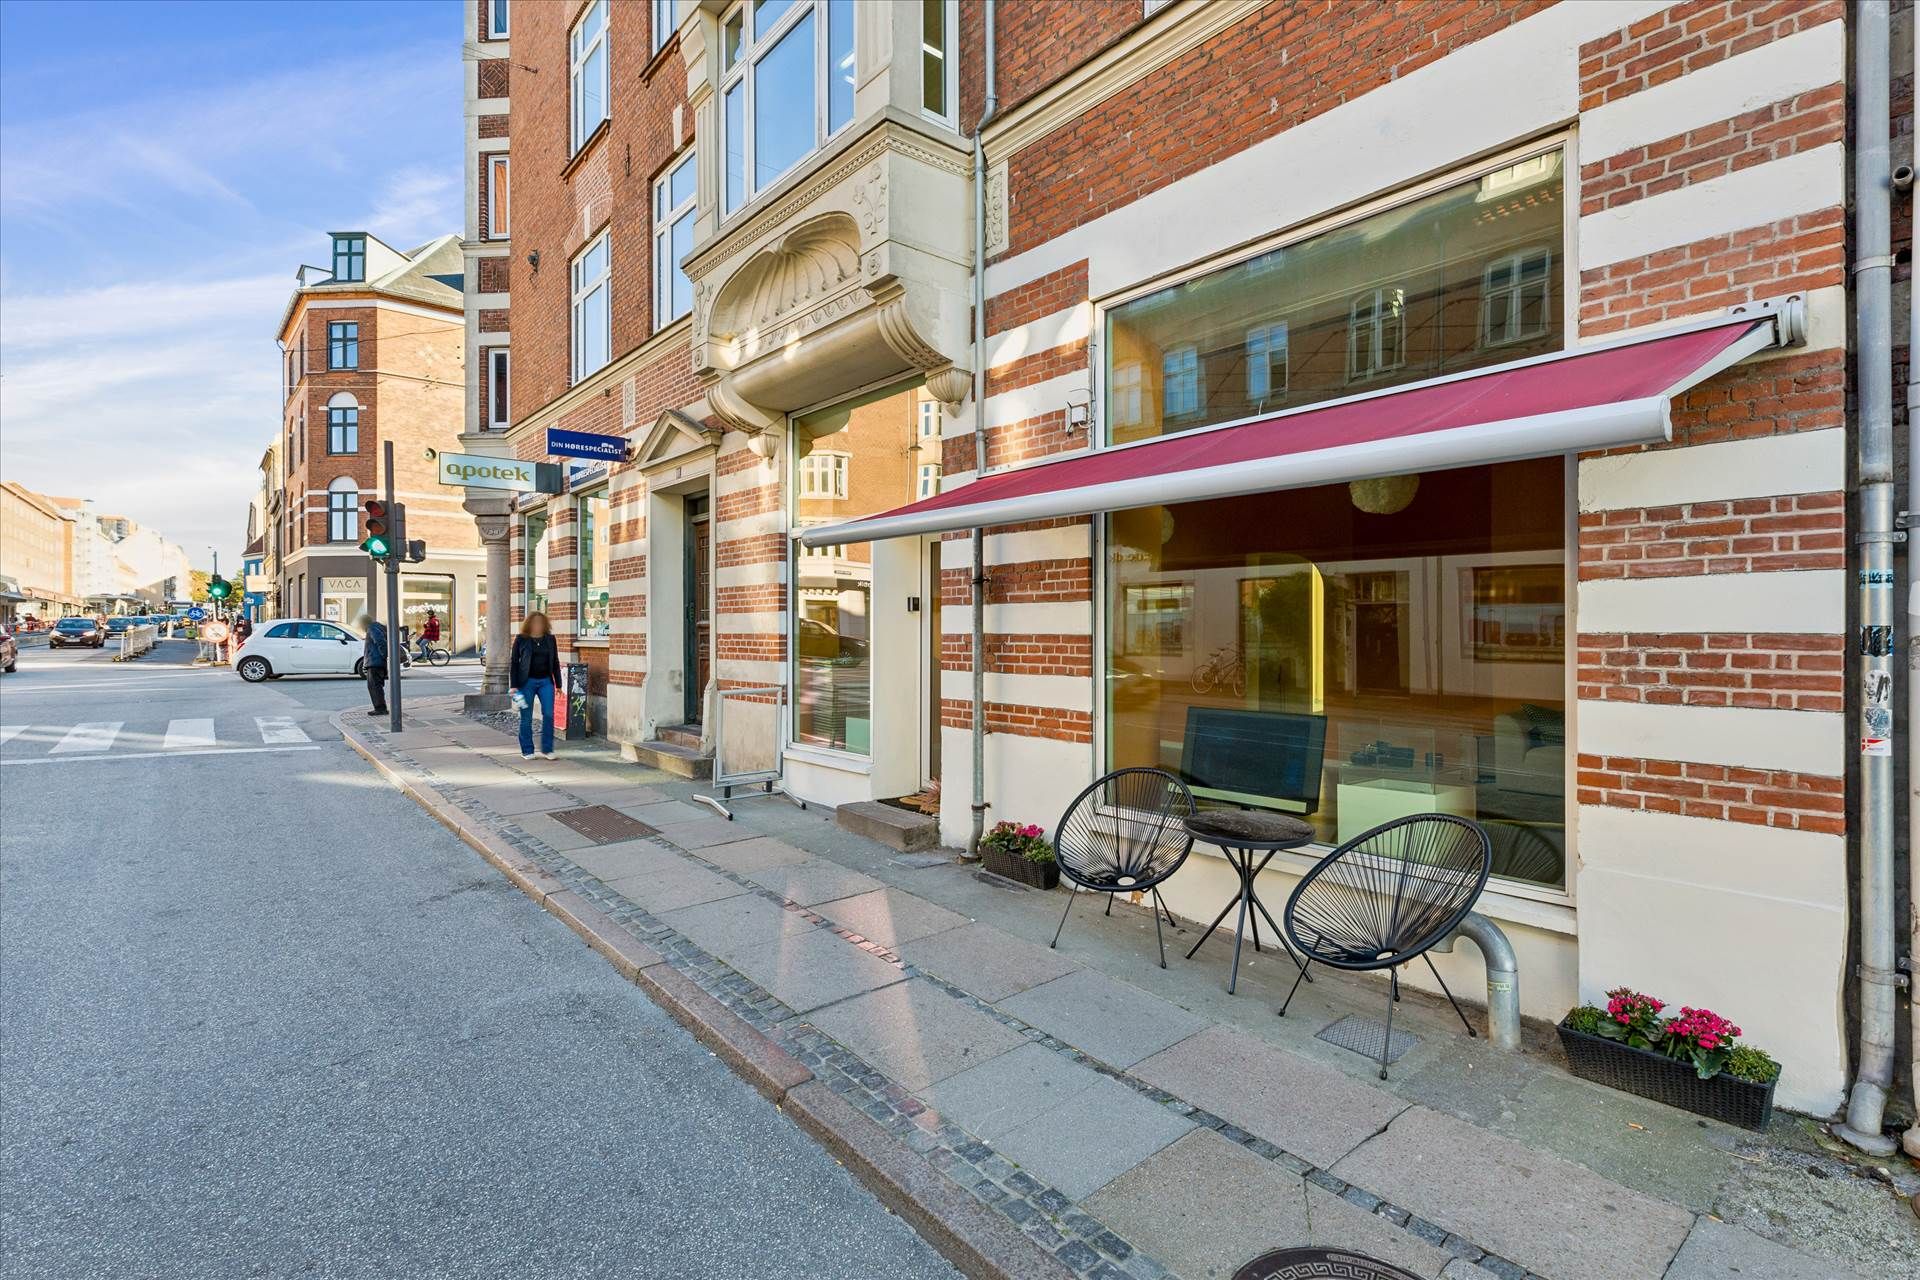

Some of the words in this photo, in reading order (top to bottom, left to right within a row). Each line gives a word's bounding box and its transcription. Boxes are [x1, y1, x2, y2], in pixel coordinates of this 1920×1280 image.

[564, 443, 622, 455] HØRESPECIALIST
[446, 463, 530, 482] apotek
[329, 579, 361, 588] VACA
